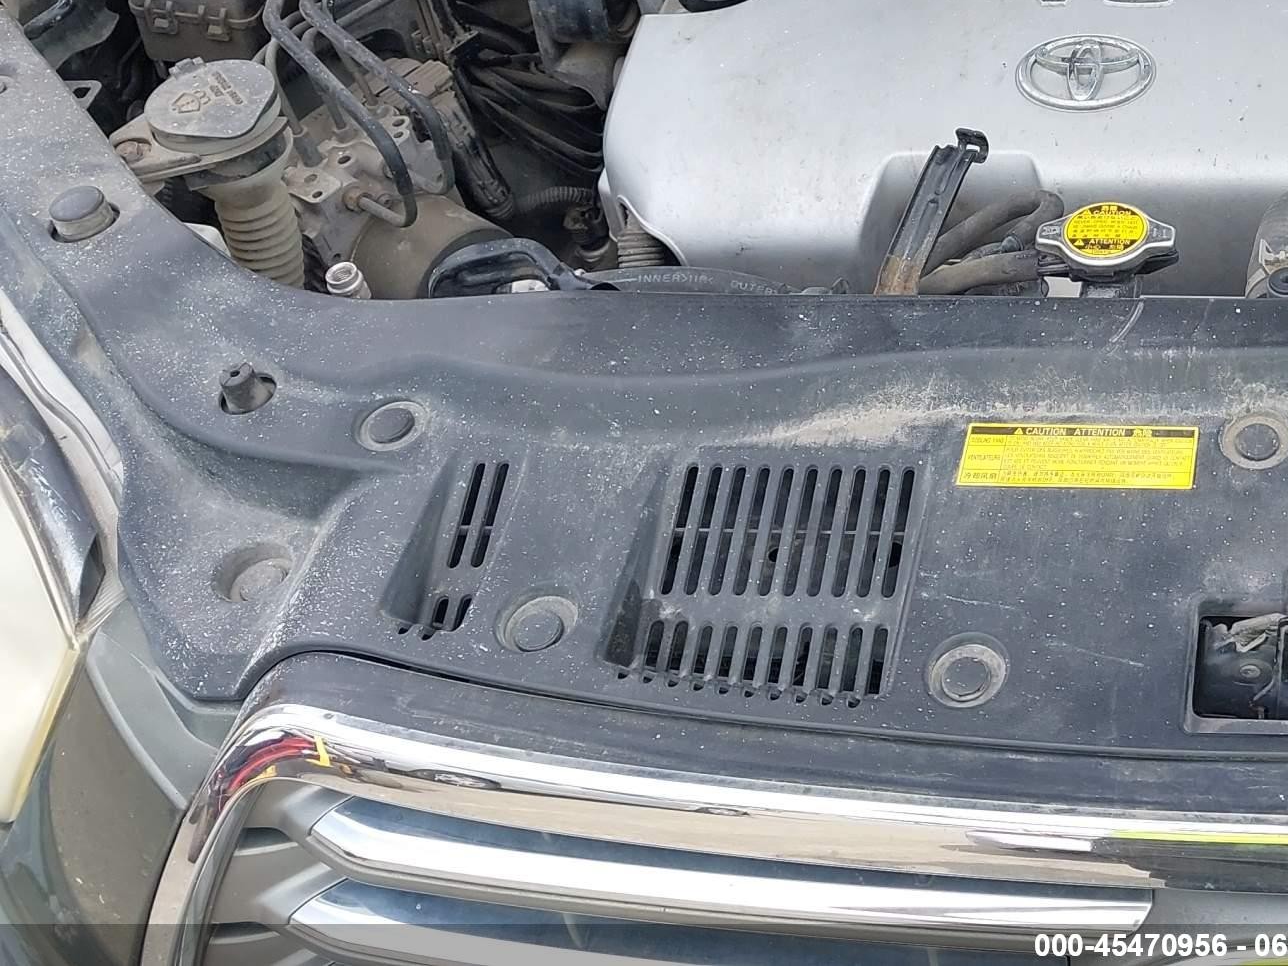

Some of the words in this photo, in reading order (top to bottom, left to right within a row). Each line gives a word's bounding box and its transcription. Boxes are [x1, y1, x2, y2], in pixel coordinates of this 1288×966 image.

[1093, 209, 1132, 217] CAUTION
[1088, 238, 1131, 246] ATTENTION
[1025, 427, 1068, 436] CAUTION
[1073, 428, 1126, 437] ATTENTION
